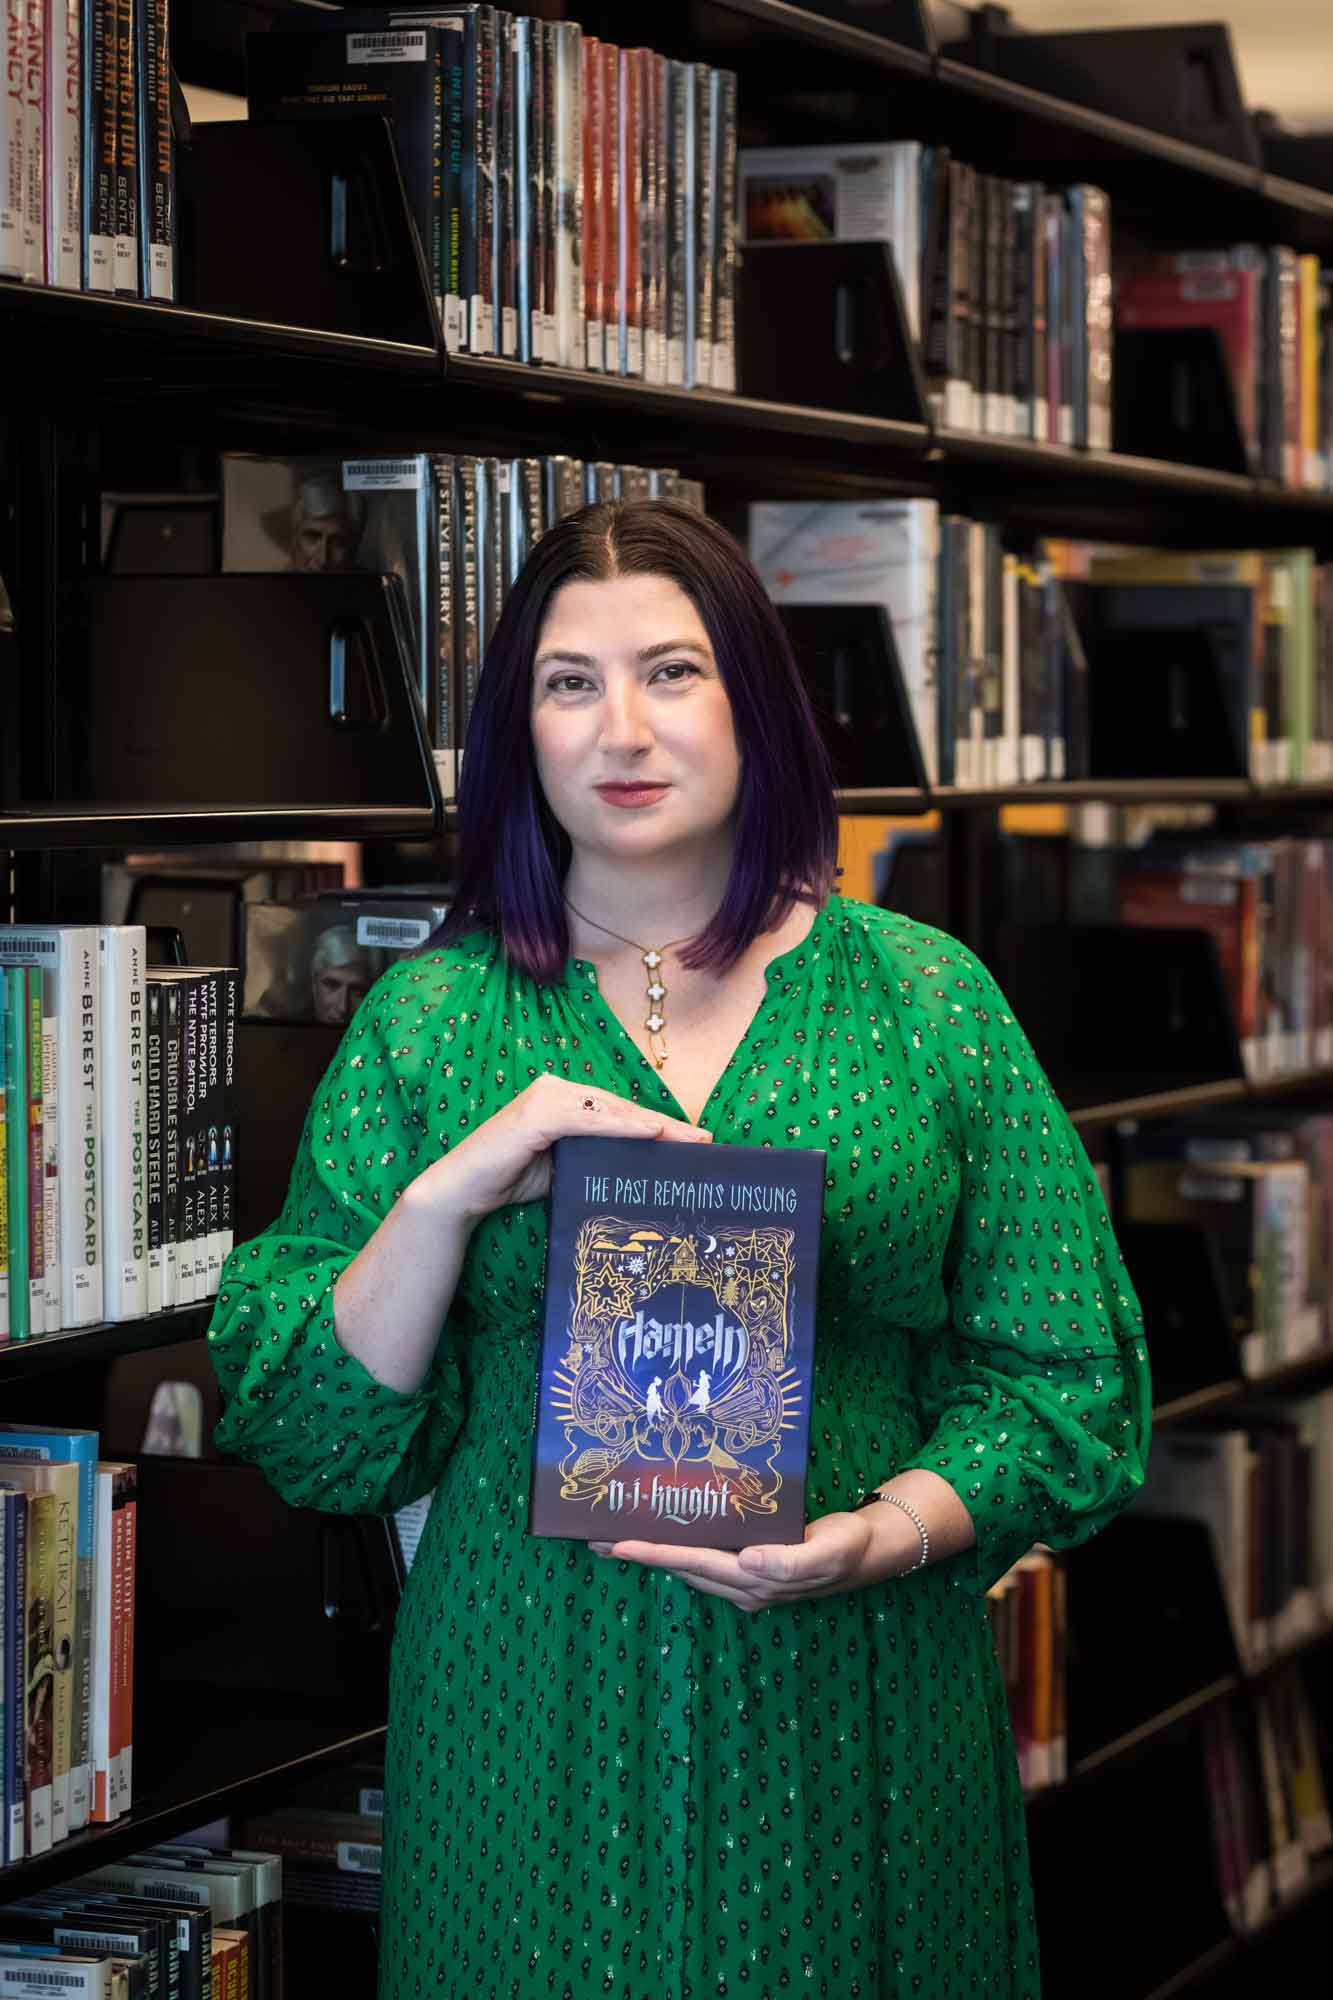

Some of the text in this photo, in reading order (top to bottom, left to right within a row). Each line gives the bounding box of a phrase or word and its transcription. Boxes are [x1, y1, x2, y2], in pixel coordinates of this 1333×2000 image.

[119, 37, 137, 167] SANCTION
[439, 490, 450, 555] STEVE
[529, 492, 541, 541] STEV
[439, 561, 451, 625] BERRY
[464, 490, 475, 626] STEVE BERRY
[82, 994, 95, 1091] BEREST
[130, 991, 142, 1086] BEREST
[186, 989, 197, 1115] THE NYTE PATROL
[199, 984, 208, 1099] NYTE PROWLER
[209, 980, 217, 1087] NYTE TERRORS
[225, 980, 235, 1087] NYTE TERRORS
[149, 1034, 161, 1204] COLD HARD STEELE
[167, 1039, 178, 1195] CRUCIBLE STEELE
[84, 1104, 97, 1267] THE POSTCARD
[132, 1100, 143, 1260] THE POSTCARD
[185, 1196, 193, 1232] ALEX
[197, 1190, 206, 1226] ALEX
[210, 1185, 218, 1222] ALEX
[222, 1184, 230, 1221] ALEX
[583, 1175, 798, 1215] THE PAST REMAINS UNSUNG
[618, 1309, 746, 1377] Hameln
[16, 1511, 24, 1538] THE
[16, 1543, 25, 1608] MUSEUM
[16, 1613, 24, 1633] OF
